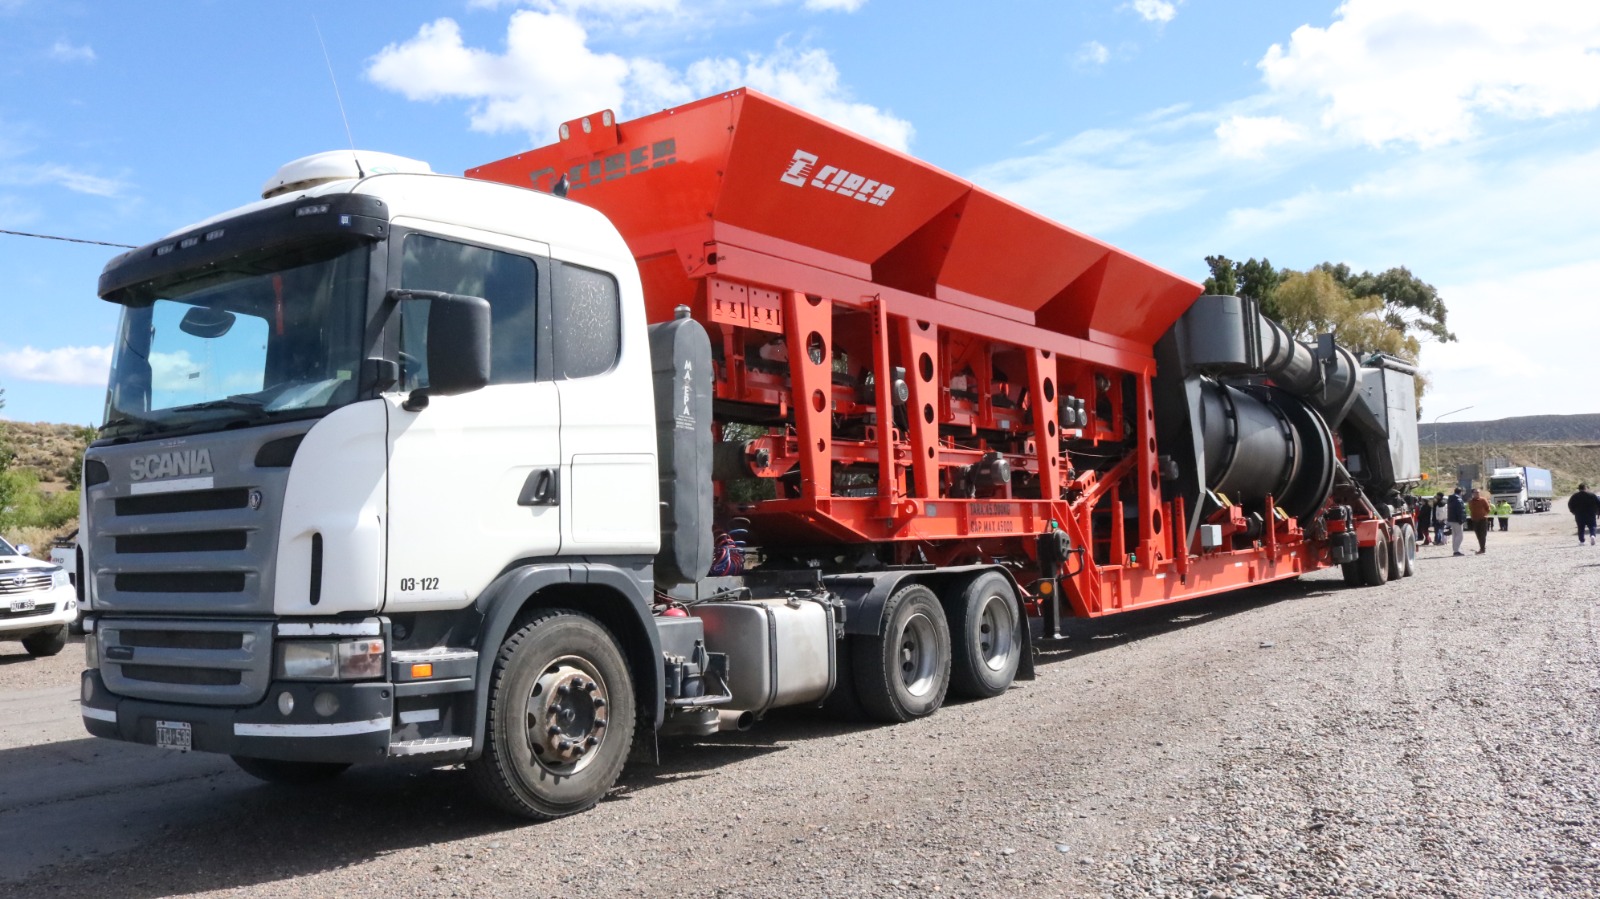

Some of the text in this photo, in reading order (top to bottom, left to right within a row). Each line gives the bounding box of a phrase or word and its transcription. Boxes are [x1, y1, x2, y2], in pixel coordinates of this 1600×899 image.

[569, 137, 676, 190] CIBER
[811, 164, 896, 207] CIBER
[130, 448, 214, 480] SCANIA
[400, 577, 440, 591] 03-122
